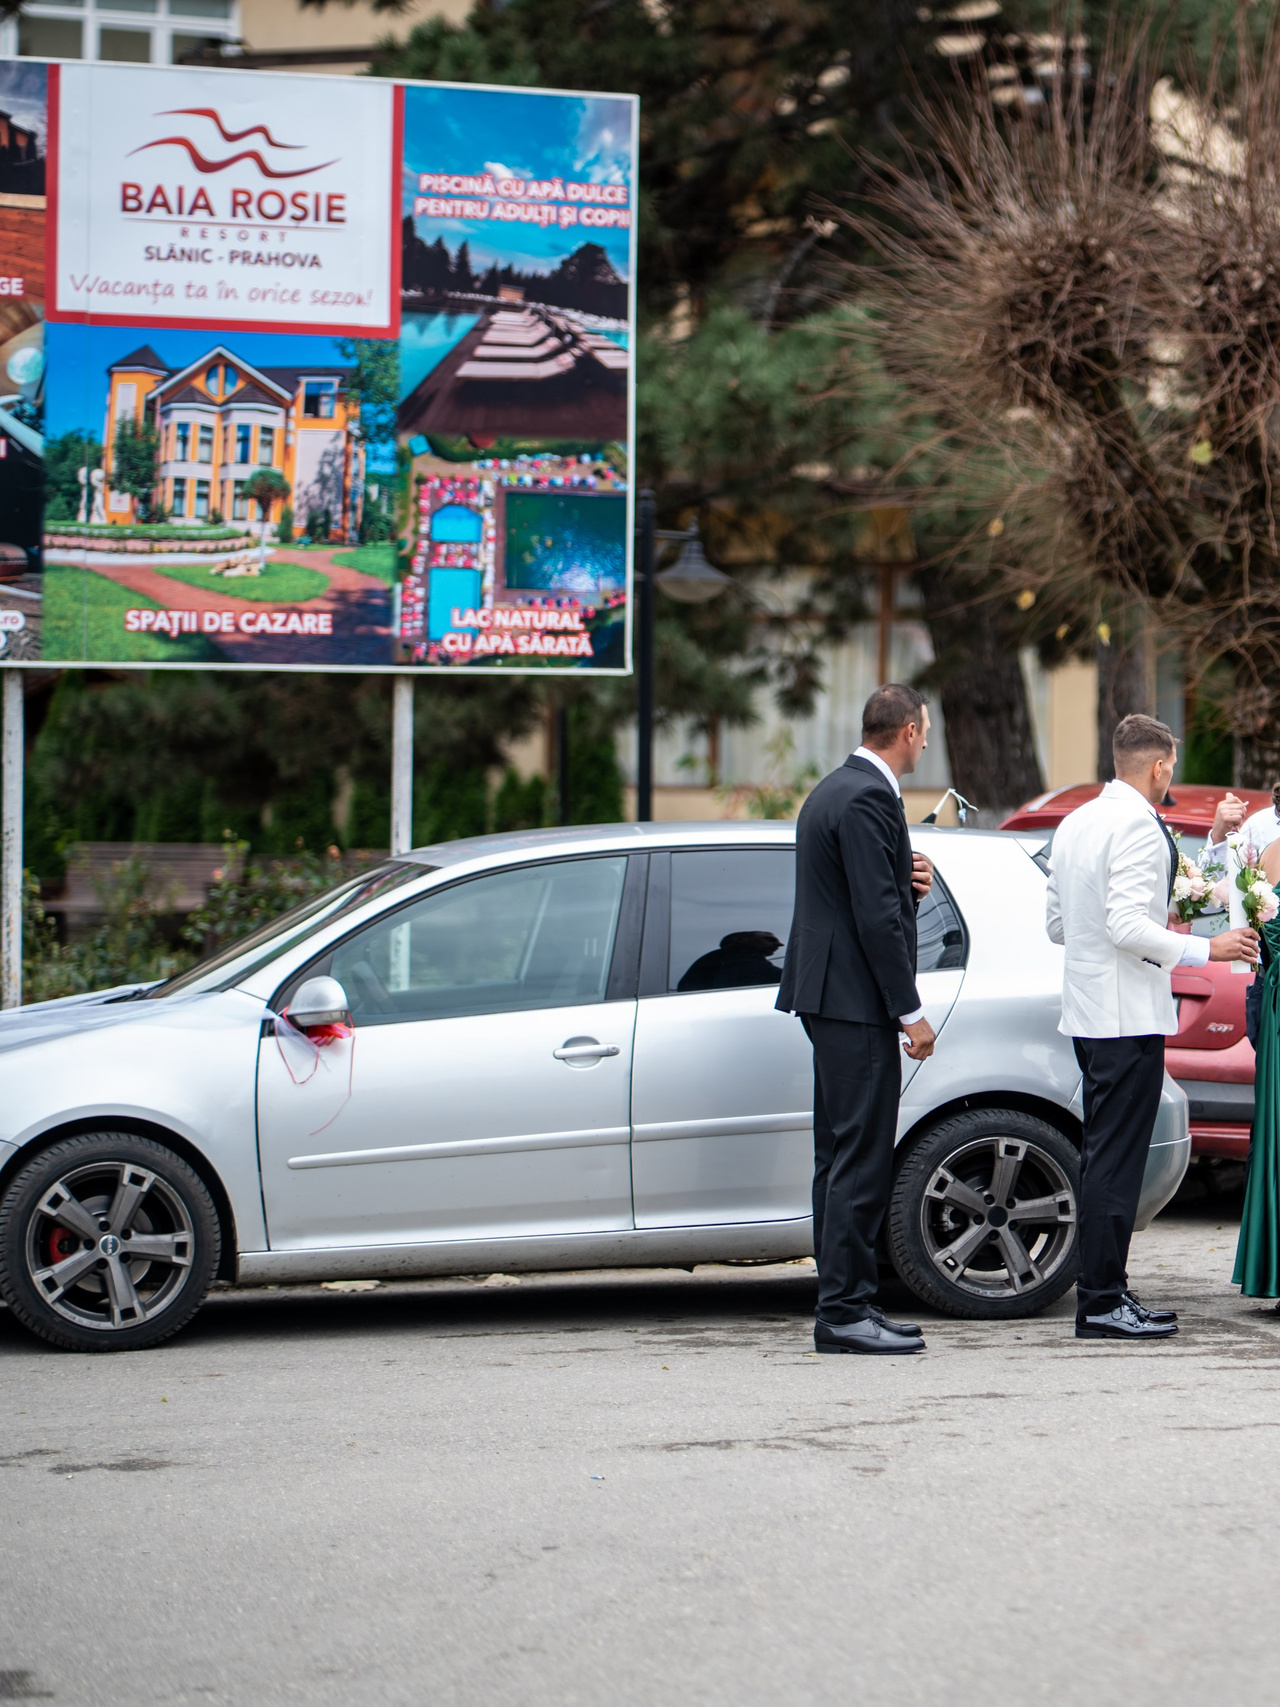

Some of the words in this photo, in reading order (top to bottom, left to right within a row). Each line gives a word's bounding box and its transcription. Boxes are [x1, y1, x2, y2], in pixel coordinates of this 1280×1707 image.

[120, 181, 216, 217] BAIA
[419, 172, 497, 196] PISCINĂ
[497, 177, 525, 199] CU
[526, 177, 565, 201] APĂ
[566, 181, 629, 205] DULCE
[414, 196, 490, 219] PENTRU
[491, 202, 557, 228] ADULȚI
[181, 227, 288, 242] RESORT
[144, 243, 214, 264] SLĂNIC
[229, 249, 322, 270] PRAHOVA
[184, 281, 209, 300] ta
[248, 281, 301, 304] orice
[125, 608, 199, 638] SPAȚII
[202, 610, 236, 633] DE
[238, 611, 334, 635] CAZARE
[451, 607, 494, 629] LAC
[494, 609, 586, 632] NATURAL
[441, 631, 473, 653] CU
[474, 631, 516, 656] APĂ
[517, 632, 594, 657] SĂRATĂ
